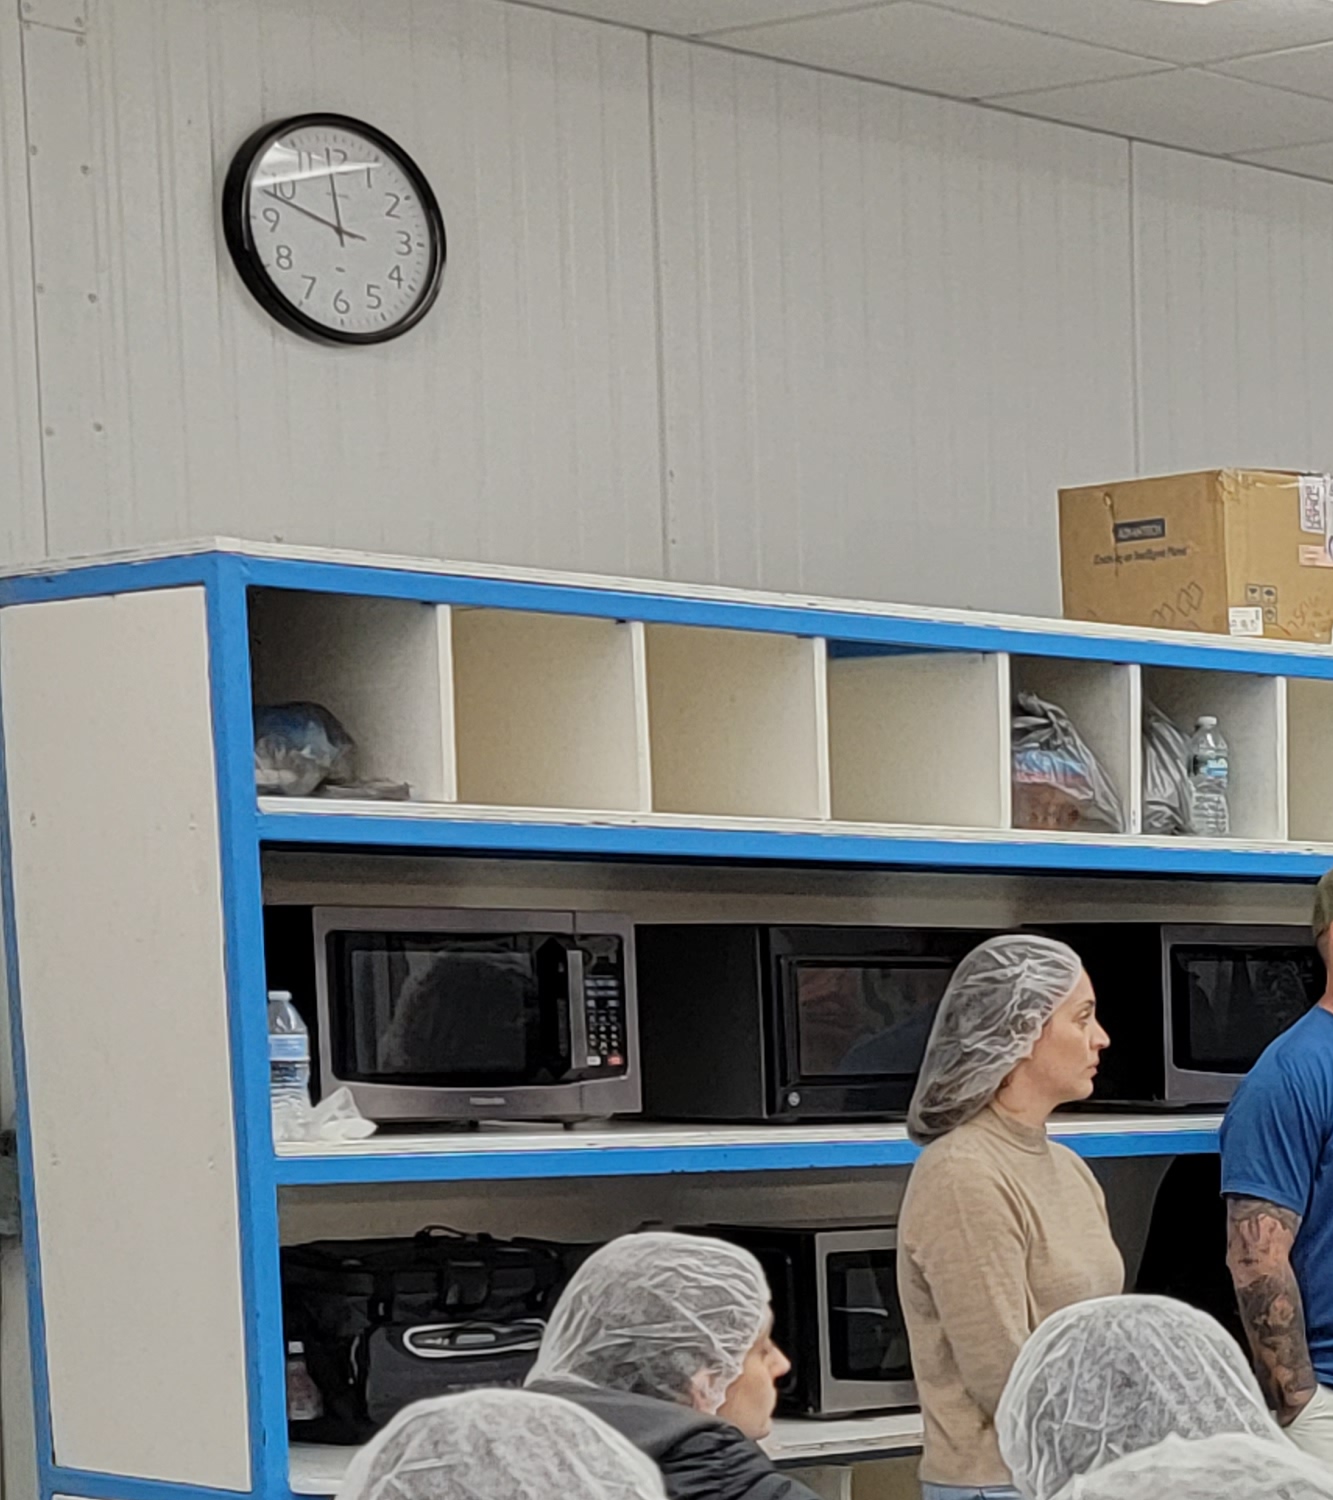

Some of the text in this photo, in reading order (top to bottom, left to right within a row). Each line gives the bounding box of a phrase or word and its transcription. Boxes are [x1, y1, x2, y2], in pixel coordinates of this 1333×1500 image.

[384, 192, 401, 219] 2
[262, 207, 280, 232] 9
[395, 231, 413, 256] 3
[276, 245, 293, 270] 8
[301, 274, 316, 300] 7
[388, 265, 404, 289] 4
[333, 289, 350, 315] 6
[366, 283, 382, 310] 5
